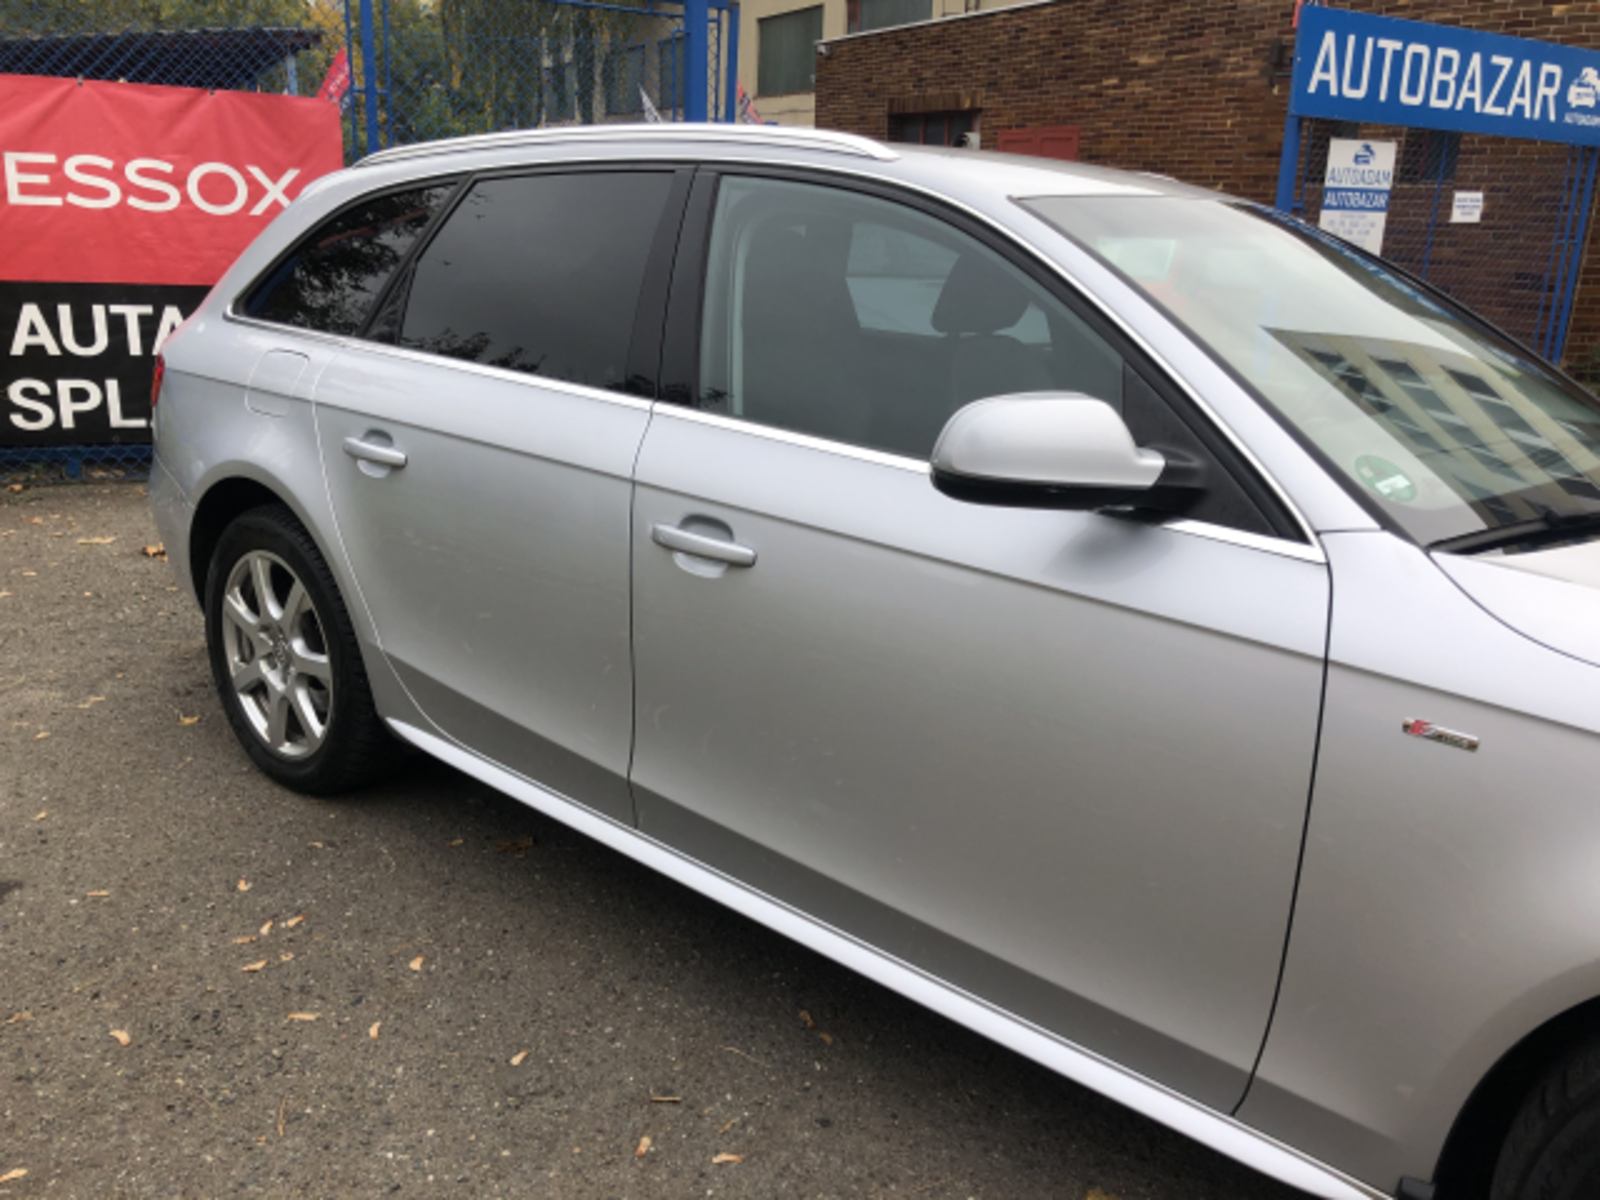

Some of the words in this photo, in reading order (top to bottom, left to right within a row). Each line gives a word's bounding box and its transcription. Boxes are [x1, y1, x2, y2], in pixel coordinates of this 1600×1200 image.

[1307, 31, 1562, 122] AUTOBAZAR
[4, 152, 300, 216] ESSOX
[1324, 191, 1389, 208] AUTOBAZAR
[1328, 167, 1391, 186] AUTOADAM
[7, 378, 153, 431] SPL
